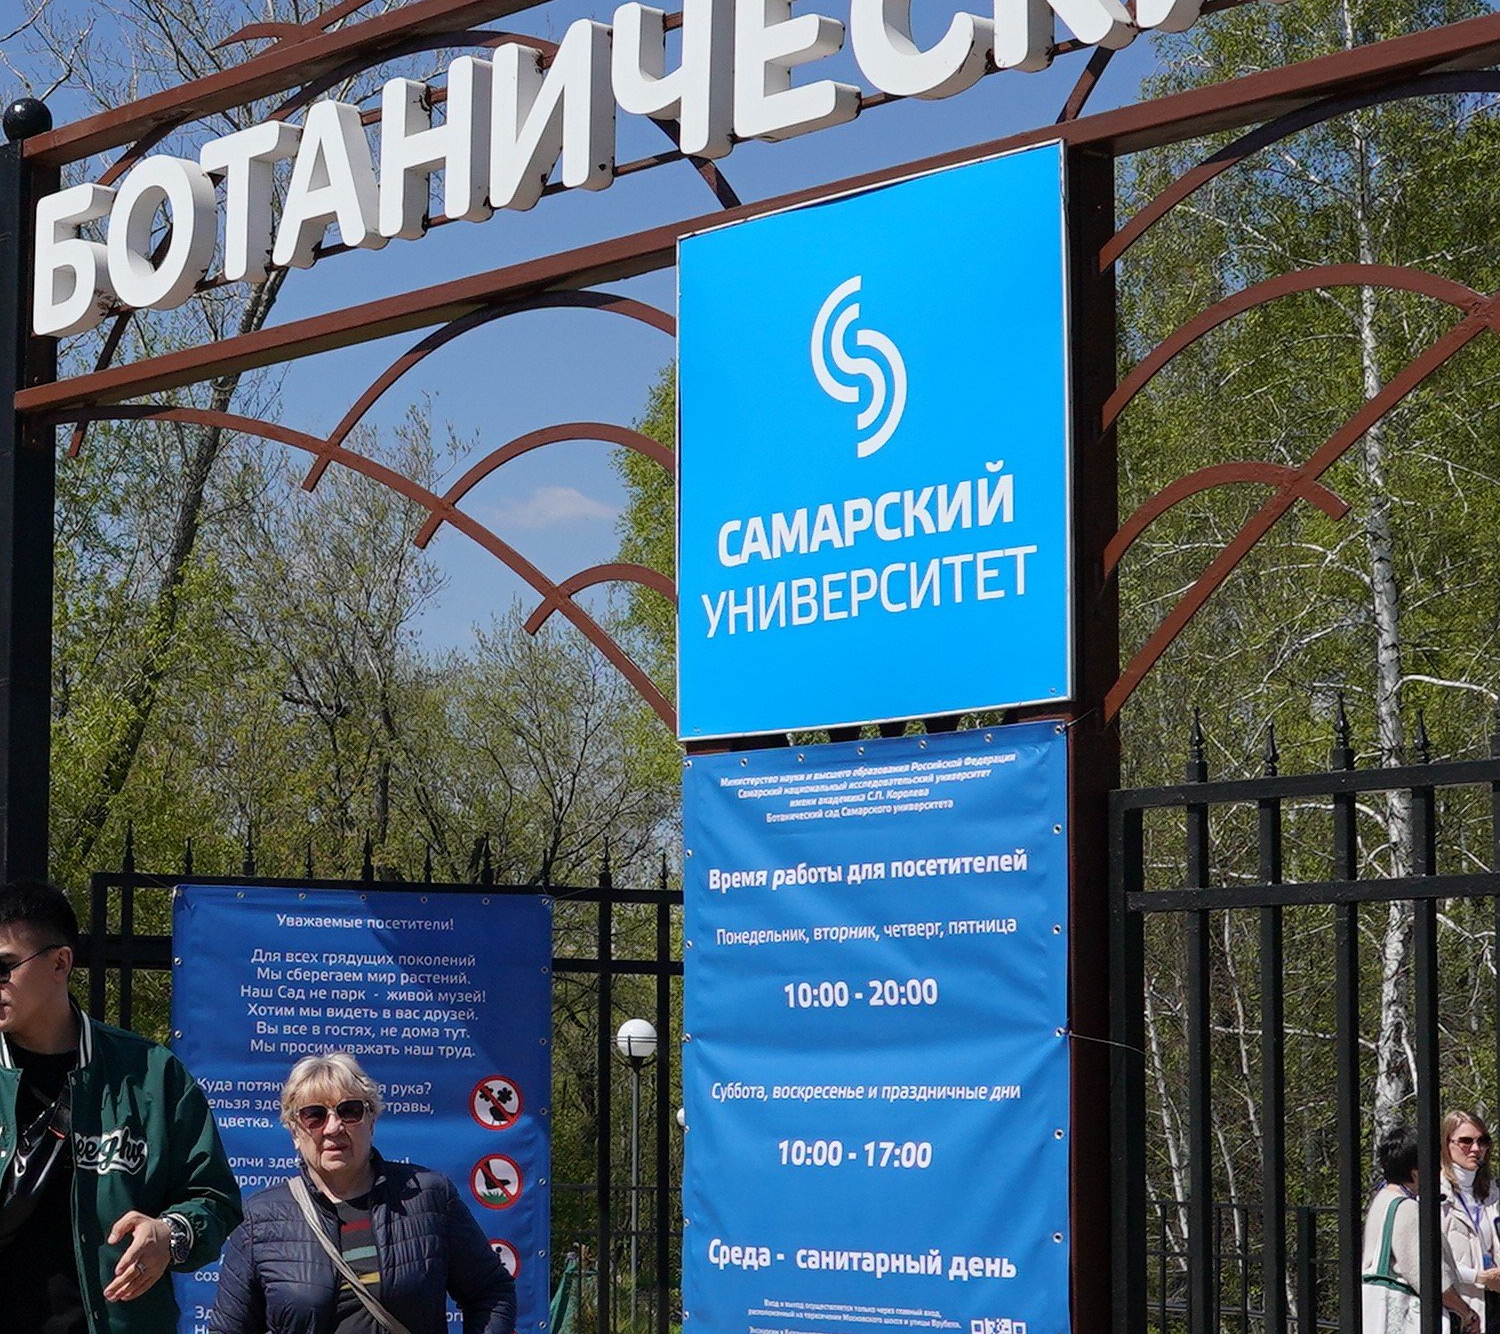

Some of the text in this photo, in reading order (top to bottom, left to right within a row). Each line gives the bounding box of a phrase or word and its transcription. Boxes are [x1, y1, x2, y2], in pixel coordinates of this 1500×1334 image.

[717, 459, 1015, 567] САМАРСКИЙ
[701, 545, 1037, 639] УНИВЕРСИТЕТ
[911, 758, 962, 771] Российской
[964, 753, 1016, 766] Федерации
[738, 787, 782, 799] Самарский
[935, 769, 992, 784] университет
[867, 790, 884, 801] С.П.
[886, 788, 929, 800] Королева
[766, 800, 954, 823] Ботанический сад Самарского университета
[709, 849, 1027, 893] Время работы для посетителей
[276, 913, 454, 931] Уважаемые посетители!
[716, 917, 1016, 946] Понедельник, вторник, четверг, пятница
[251, 949, 476, 967] Для всех грядущих поколений
[257, 968, 471, 985] Мы сберегаем мир растений.
[240, 985, 486, 1004] Наш Сад не парк живой музей!
[784, 978, 938, 1008] 10:00 20:00
[247, 1003, 478, 1024] Хотим мы видеть в вас друзей.
[256, 1021, 471, 1039] Вы все в гостях, не дома тут.
[250, 1039, 476, 1058] Мы просим уважать наш труд.
[197, 1078, 233, 1092] Куда
[391, 1082, 432, 1096] рука?
[711, 1082, 1021, 1104] Суббота, воскресенье и праздничные дни
[208, 1098, 250, 1109] ельзя
[386, 1102, 434, 1114] травы,
[219, 1117, 274, 1129] цветка.
[228, 1158, 264, 1168] опчи
[779, 1139, 931, 1168] 10:00 17:00
[709, 1239, 1016, 1281] Среда санитарный день
